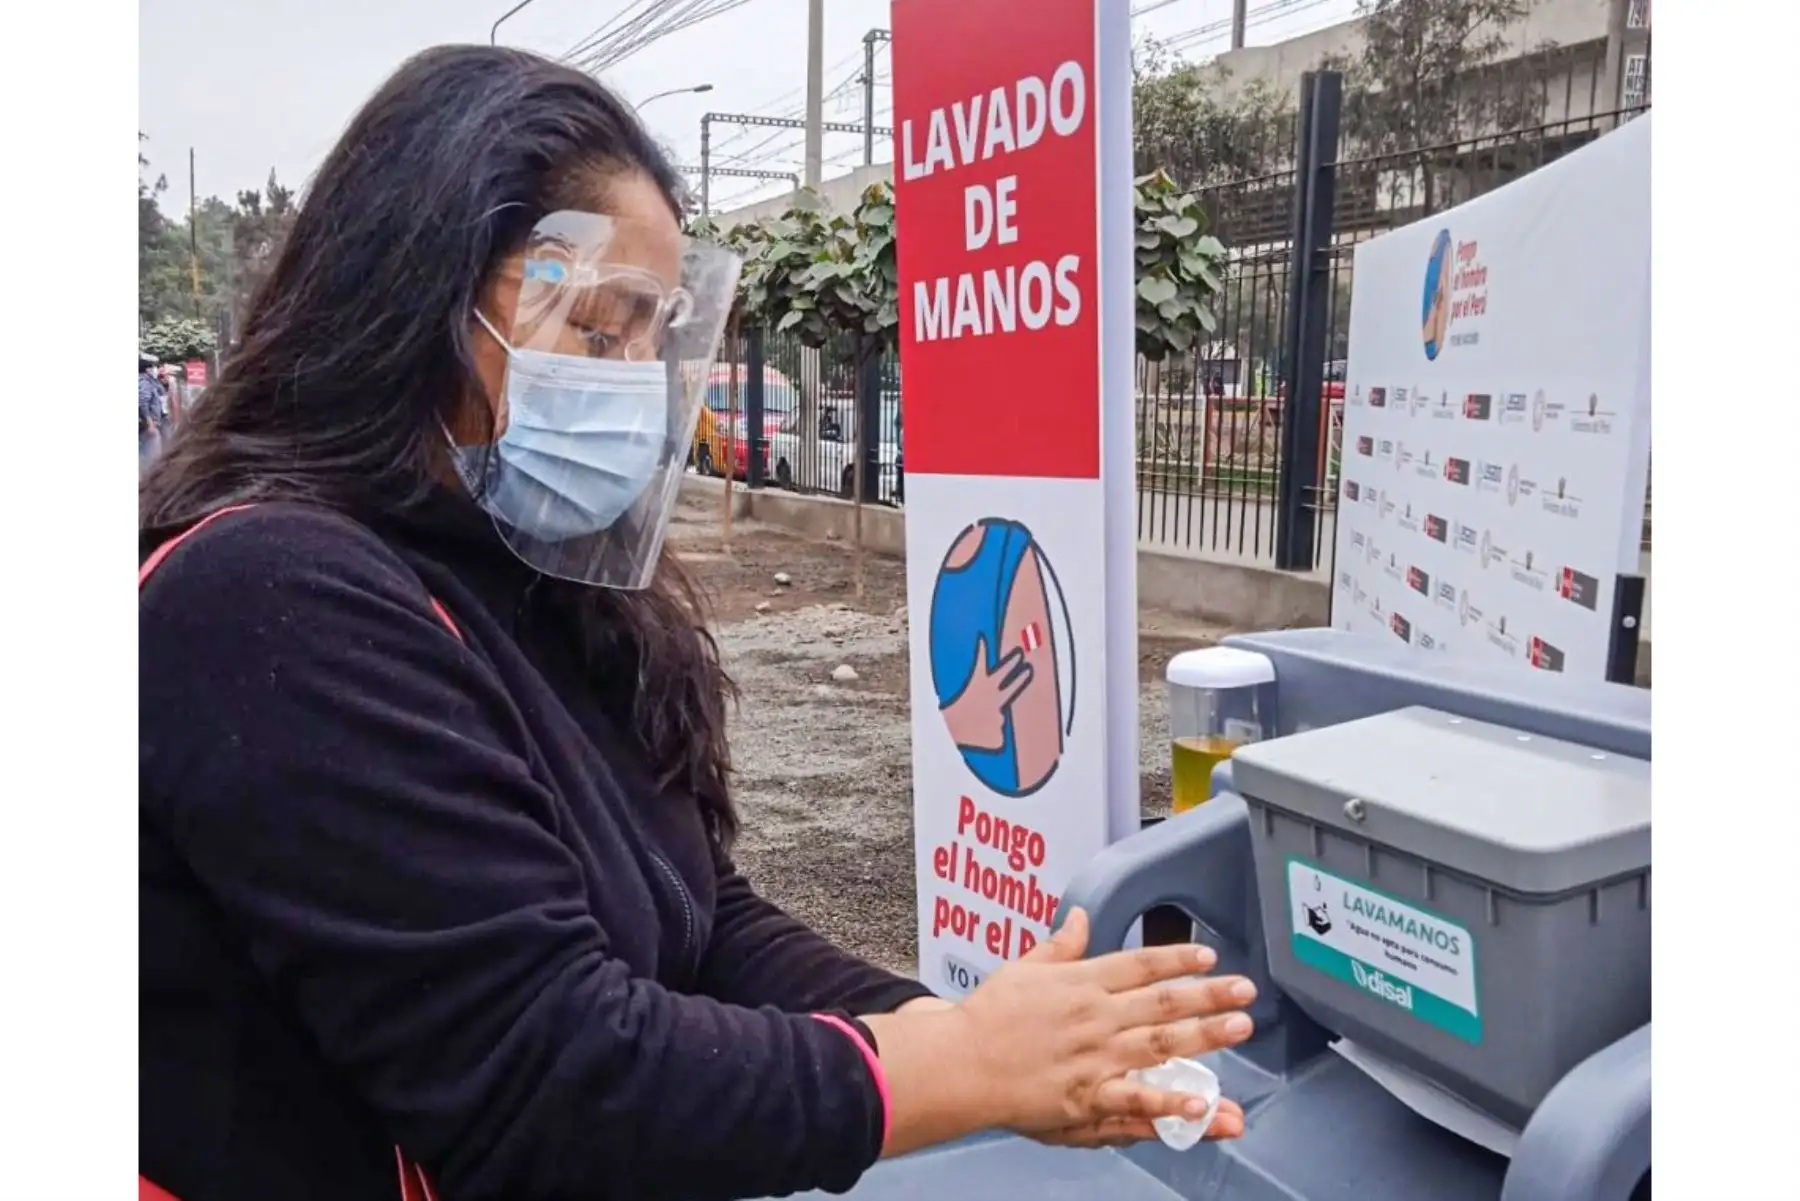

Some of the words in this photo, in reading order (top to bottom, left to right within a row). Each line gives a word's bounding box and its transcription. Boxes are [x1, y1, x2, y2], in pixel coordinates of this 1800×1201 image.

[902, 60, 1086, 181] LAVADO
[964, 175, 1018, 251] DE
[913, 254, 1081, 343] MANOS
[958, 796, 1045, 872] Pongo
[933, 841, 958, 883] el
[964, 848, 1060, 928] hombr
[933, 895, 980, 942] por
[985, 916, 1012, 960] el
[1344, 892, 1460, 955] LAVAMANOS
[948, 960, 969, 988] YO
[1368, 971, 1413, 1008] disal
